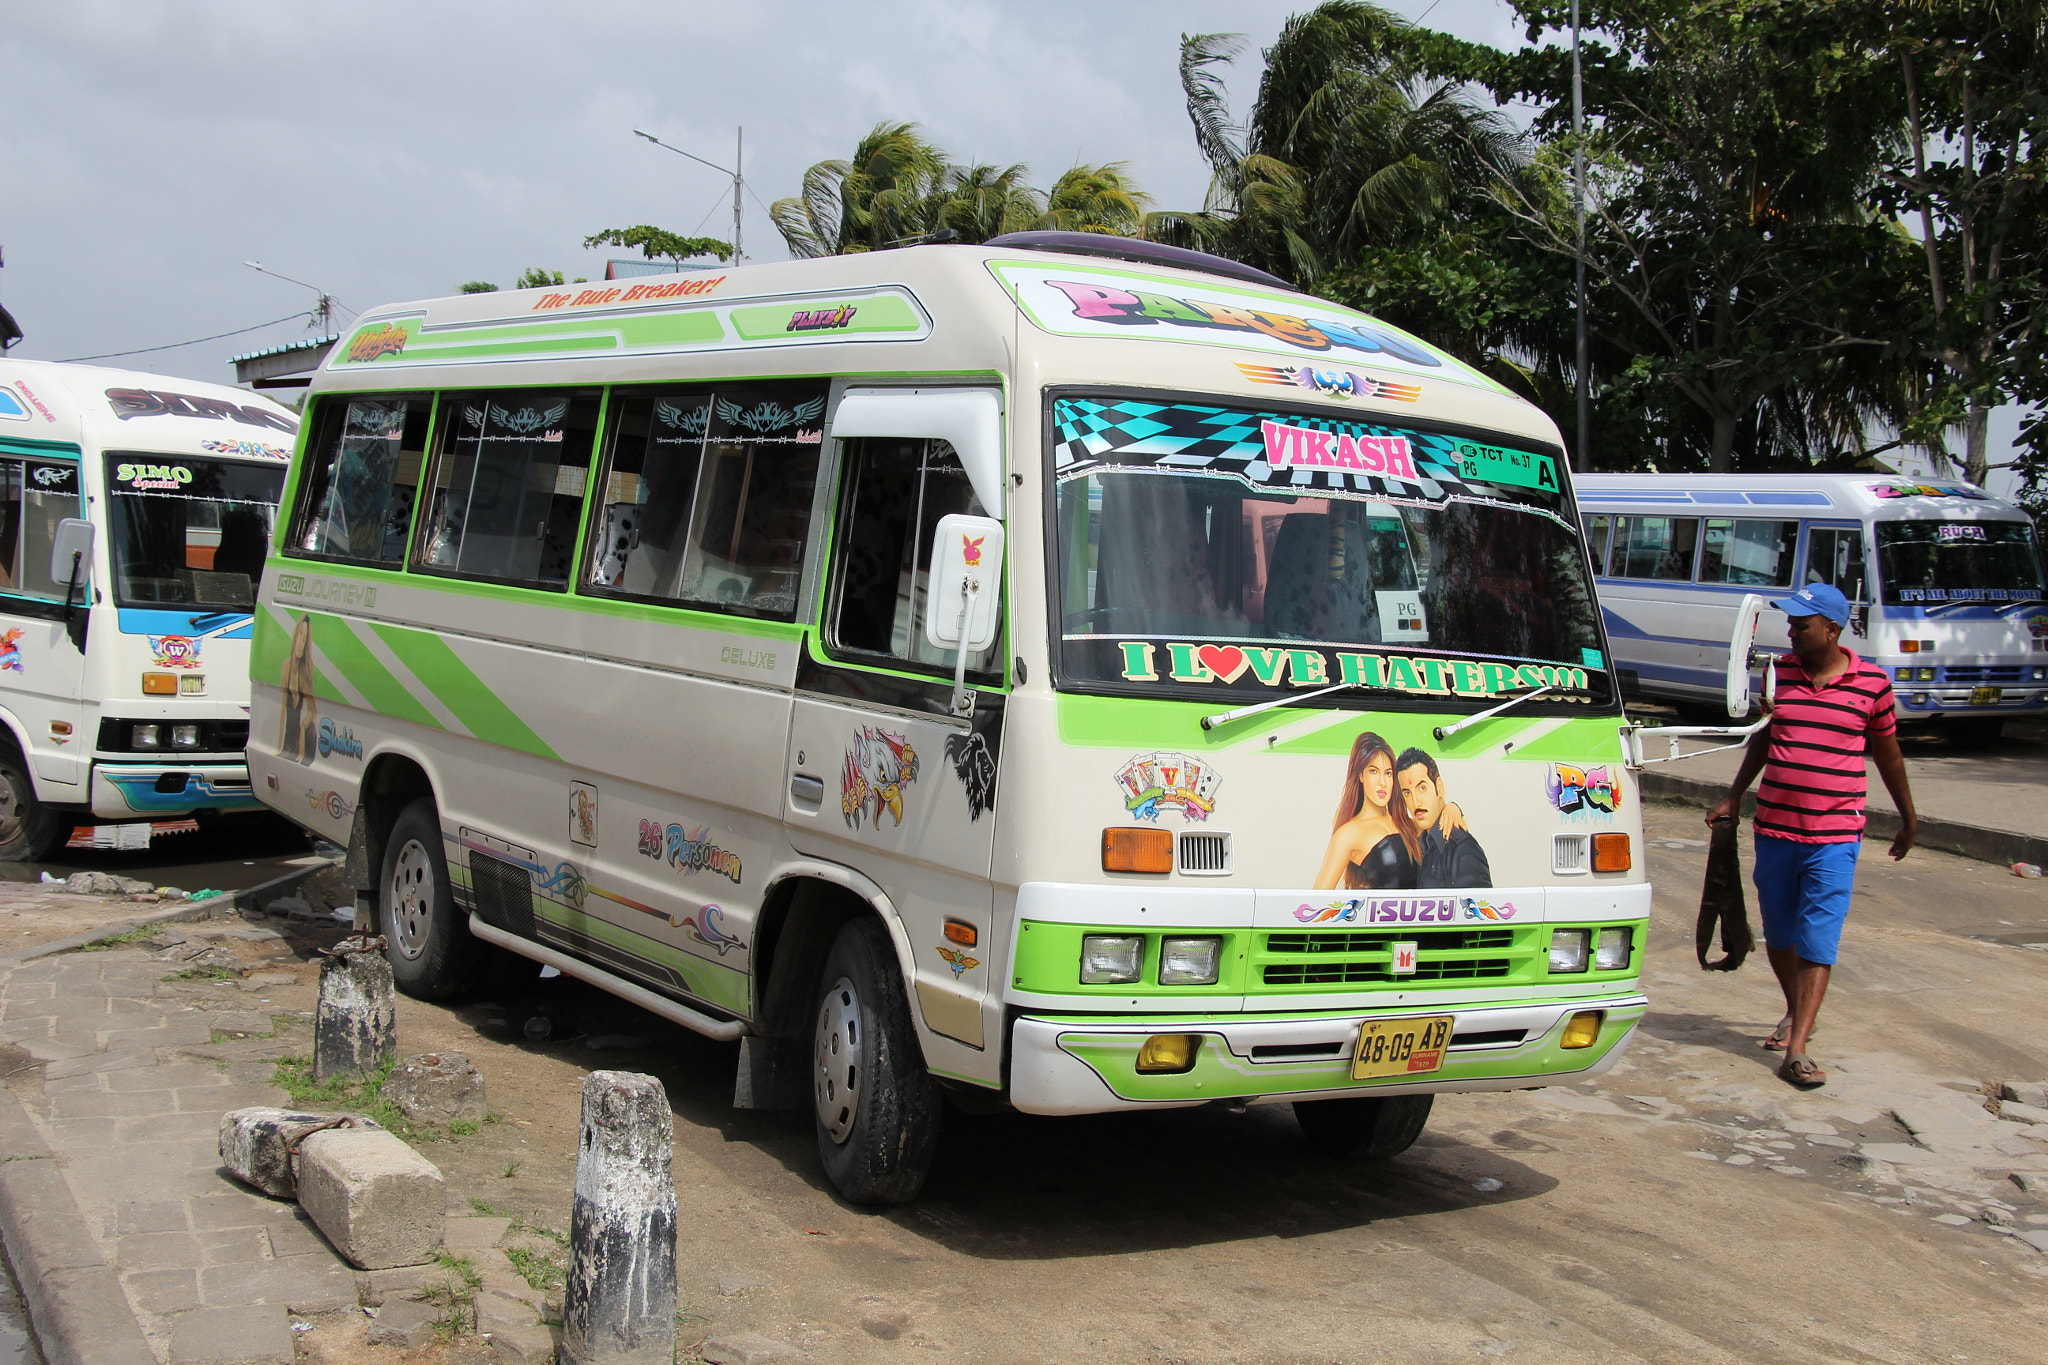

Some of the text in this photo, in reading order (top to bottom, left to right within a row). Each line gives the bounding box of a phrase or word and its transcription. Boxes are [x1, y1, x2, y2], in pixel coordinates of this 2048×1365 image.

[532, 275, 727, 311] The Rule Breaker!
[786, 304, 858, 332] PLAYBY
[14, 380, 57, 423] EXCLUSIVE
[1261, 418, 1422, 486] VIKASH
[1479, 447, 1504, 462] TCT
[1522, 454, 1531, 469] 37
[116, 463, 193, 484] SIMO
[1463, 461, 1478, 477] PG
[1538, 460, 1556, 489] A
[132, 477, 180, 490] Special
[1939, 525, 1988, 541] RUCH
[279, 575, 304, 595] ISUZU
[305, 579, 365, 606] JOURNEY
[1899, 589, 2042, 601] IT'S ALL ABOUT THE MONEY
[1396, 602, 1417, 616] PG
[720, 645, 777, 671] DELUXE
[1118, 641, 1159, 682] I
[1166, 642, 1330, 687] LVE
[318, 717, 363, 761] Shakira
[1555, 762, 1615, 815] PG
[638, 818, 743, 885] 26 Personen
[1369, 899, 1455, 922] ISUZU
[1411, 1051, 1439, 1060] SURINAME
